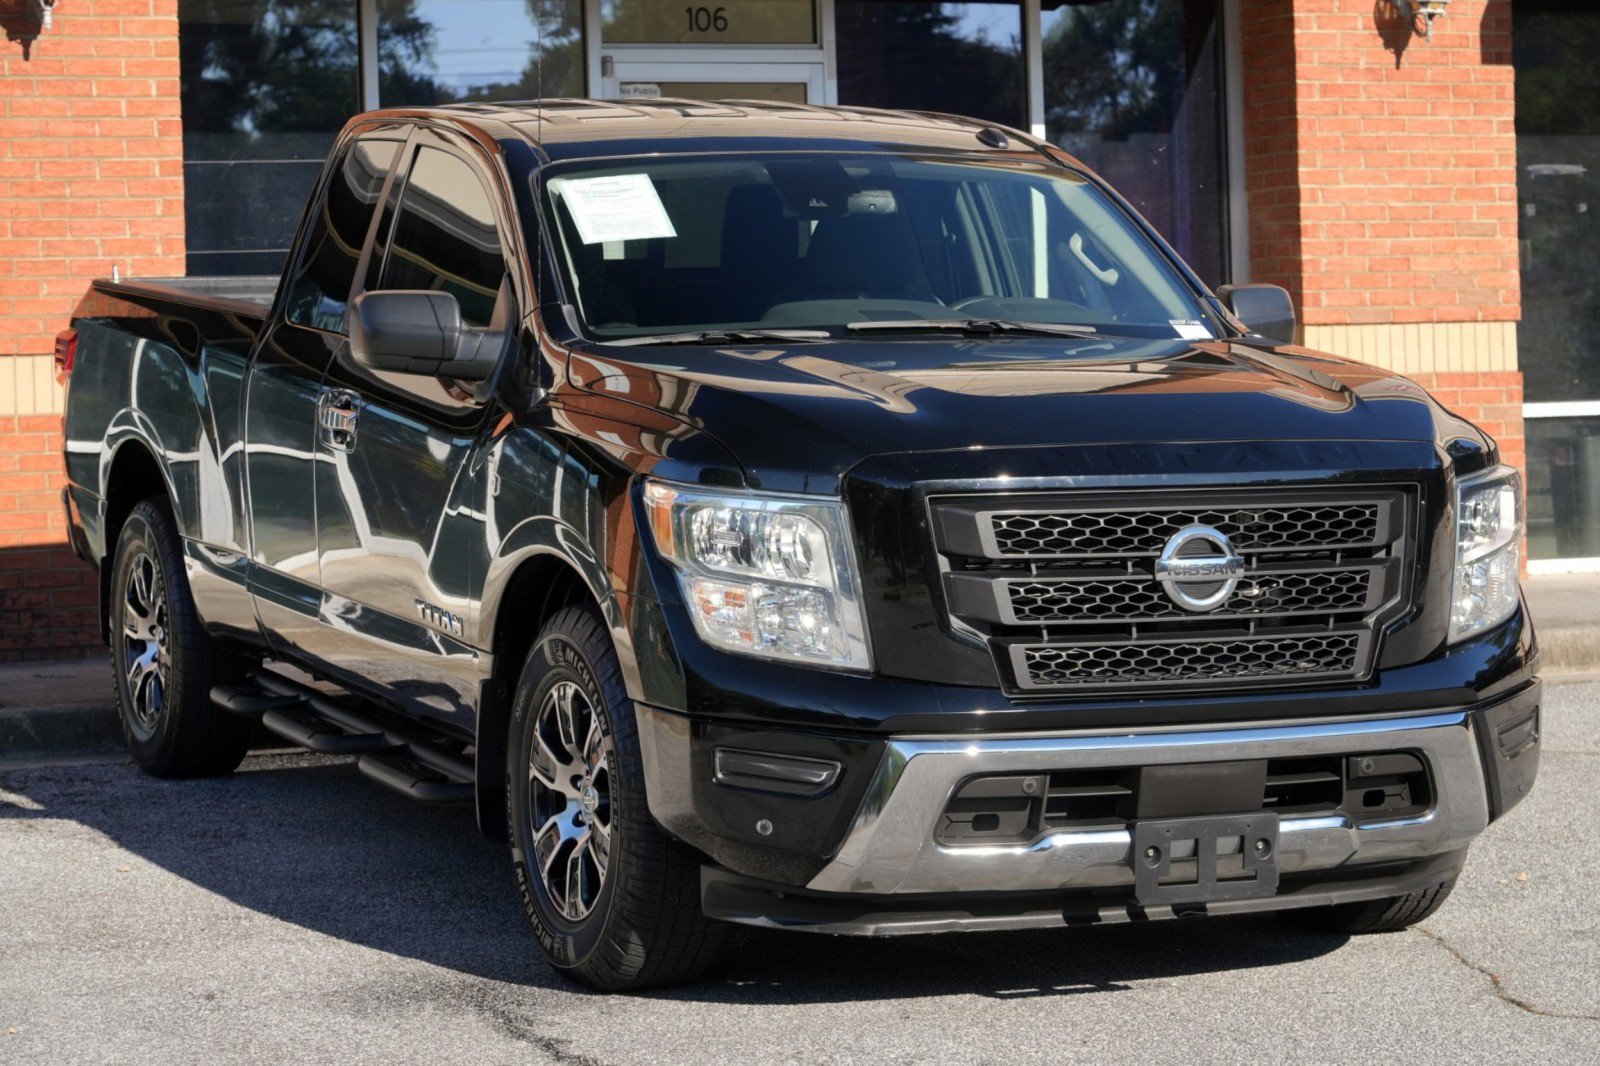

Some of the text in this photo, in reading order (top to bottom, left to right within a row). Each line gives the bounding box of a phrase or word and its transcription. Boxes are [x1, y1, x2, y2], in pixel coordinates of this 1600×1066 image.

[686, 7, 728, 32] 106
[1167, 562, 1237, 576] NISSAN
[414, 598, 464, 638] TITAN
[564, 647, 607, 731] MICHELIN
[516, 867, 553, 951] MICHELIN
